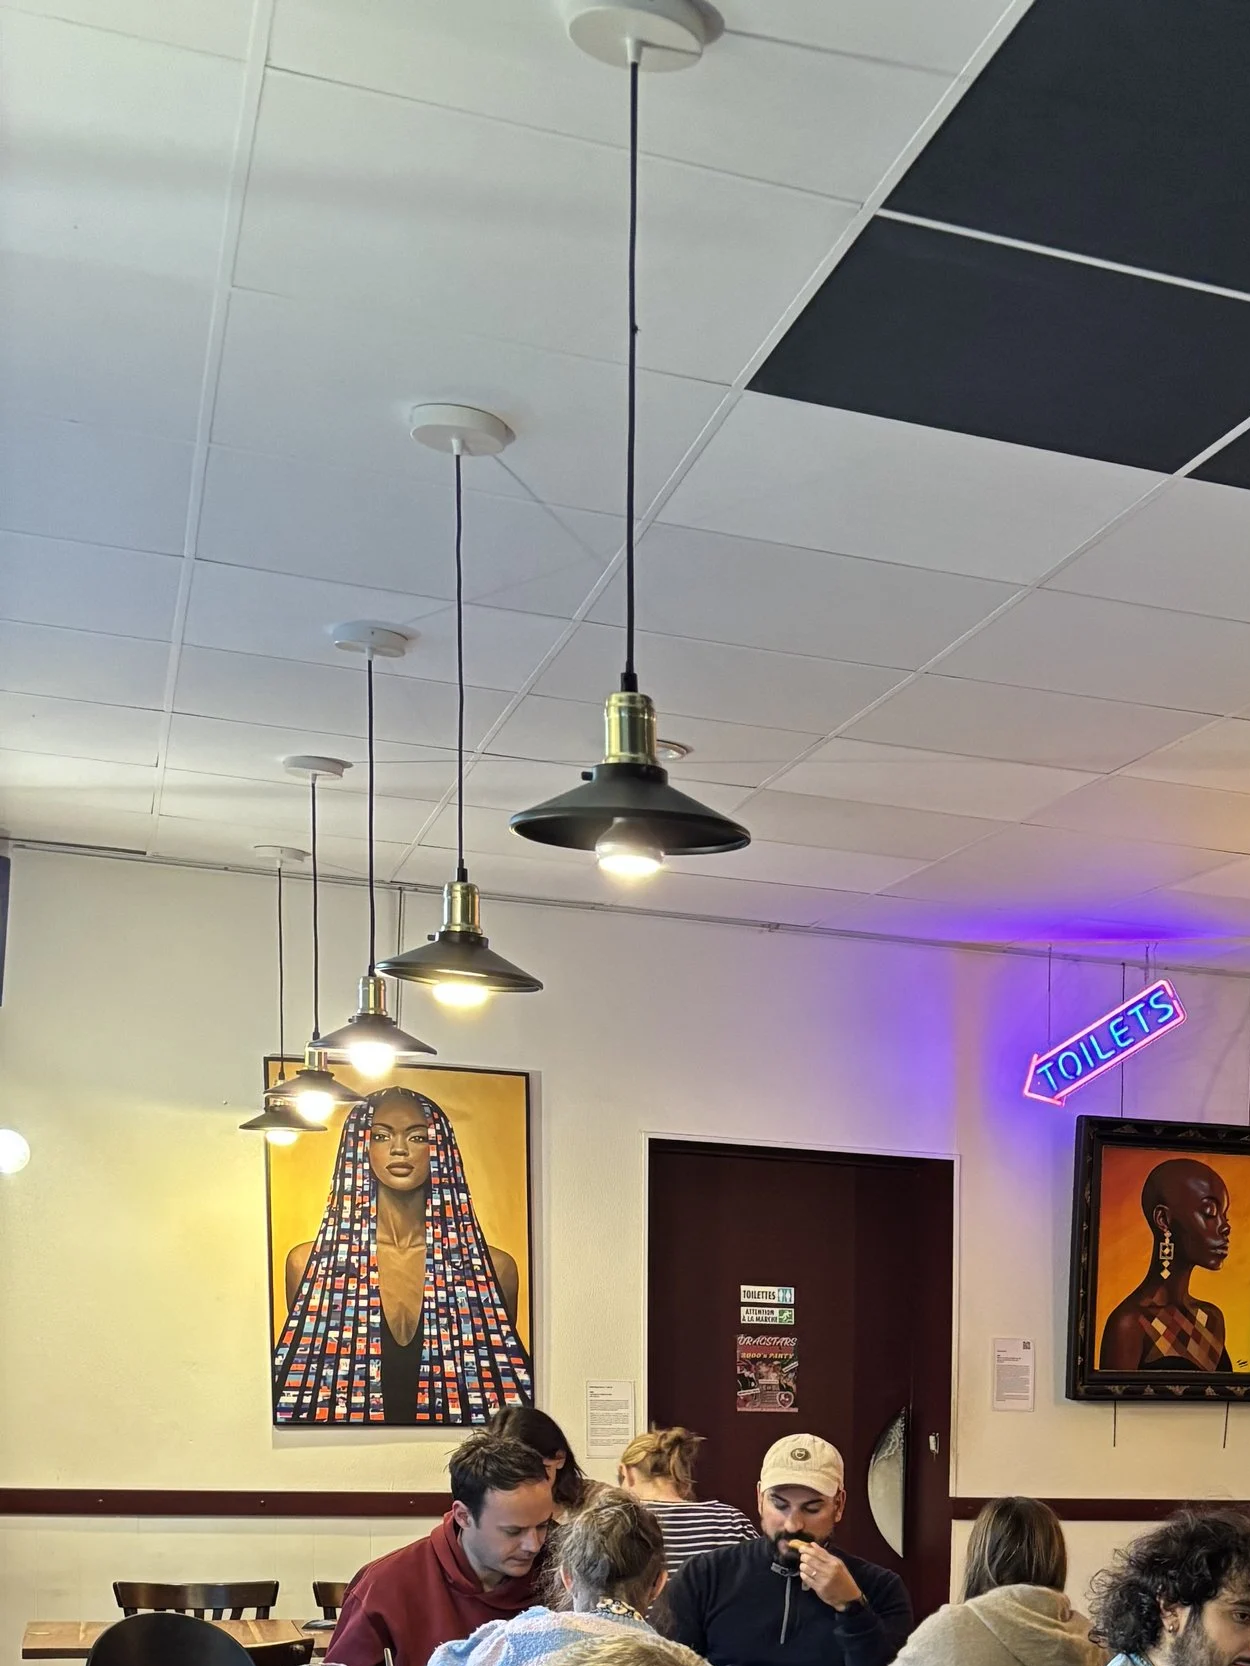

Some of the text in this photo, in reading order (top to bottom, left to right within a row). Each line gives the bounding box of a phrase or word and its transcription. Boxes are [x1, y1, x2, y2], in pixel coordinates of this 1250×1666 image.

[1036, 990, 1174, 1091] TOILETS
[743, 1290, 776, 1300] TOILETTES
[745, 1308, 775, 1316] ATTENTION
